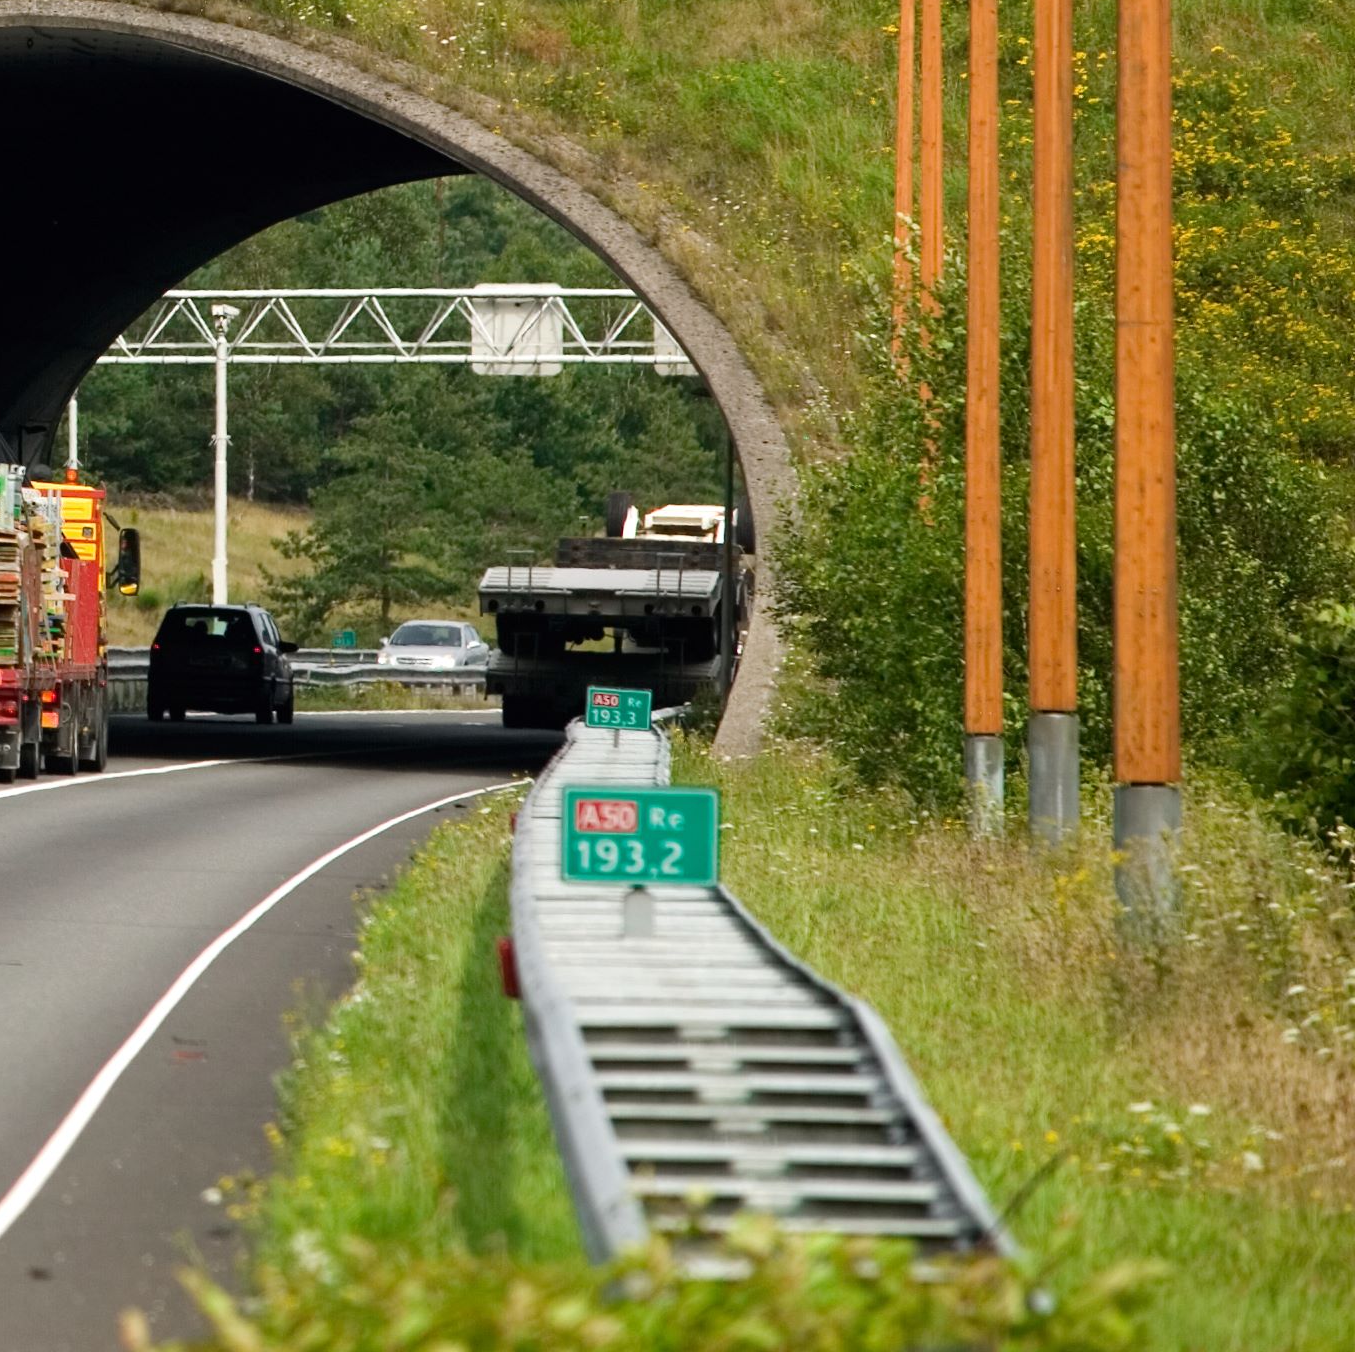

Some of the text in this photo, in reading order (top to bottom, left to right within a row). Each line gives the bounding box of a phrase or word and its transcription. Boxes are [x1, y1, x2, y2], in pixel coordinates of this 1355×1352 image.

[594, 694, 642, 708] A50 Re
[580, 804, 684, 830] A50 Re
